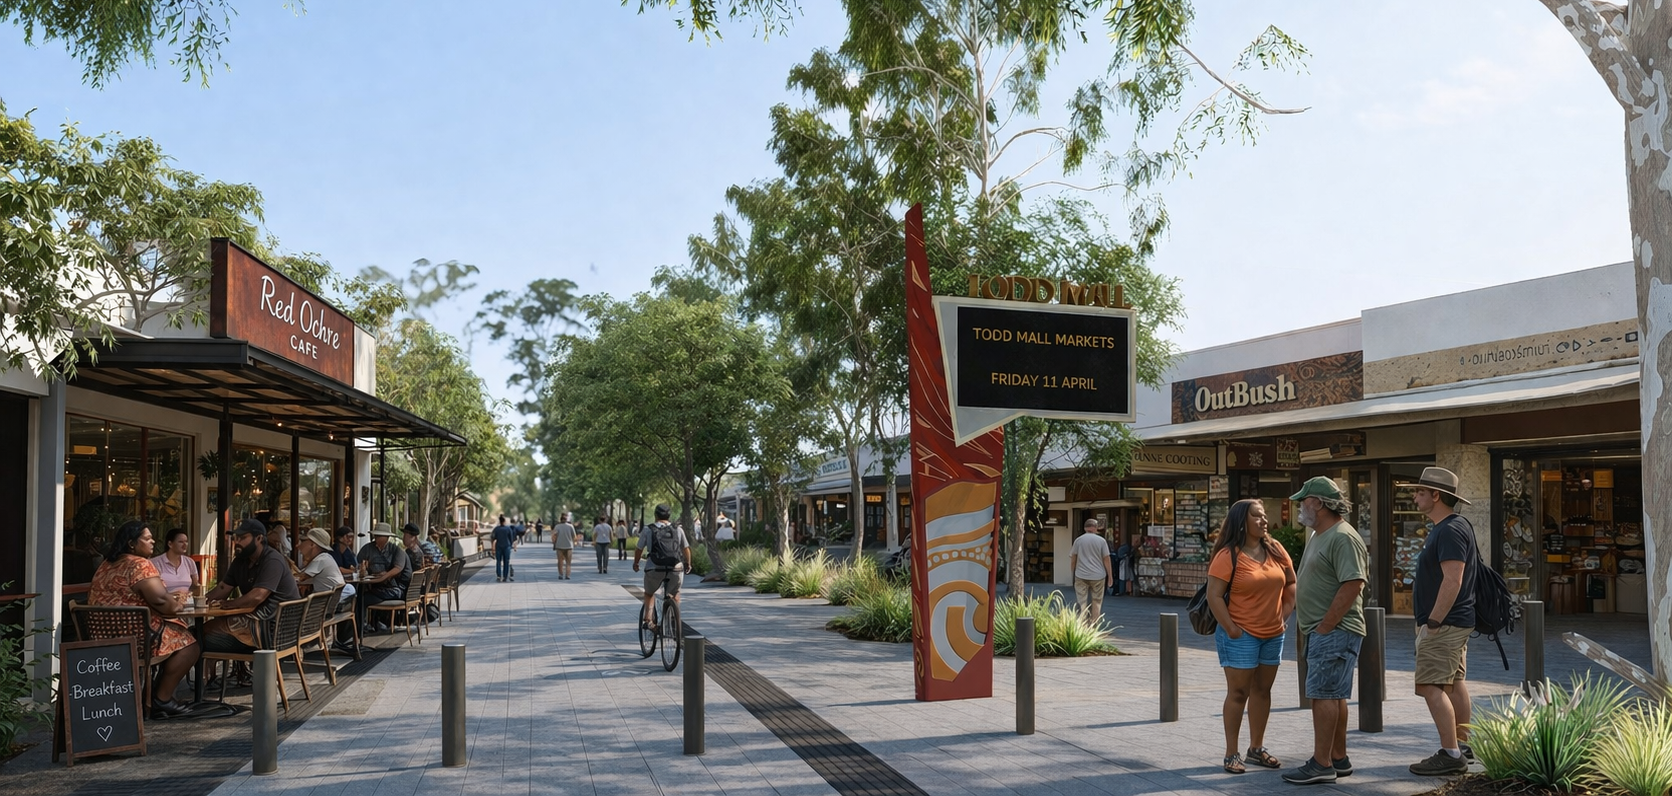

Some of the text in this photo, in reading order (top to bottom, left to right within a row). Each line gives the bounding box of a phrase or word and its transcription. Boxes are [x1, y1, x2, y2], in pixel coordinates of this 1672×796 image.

[261, 275, 340, 350] Red Ochre
[290, 334, 318, 360] CAFE
[972, 327, 1115, 349] TODD MALL MARKETS
[991, 372, 1098, 391] FRIDAY 11 APRIL
[1195, 374, 1297, 413] OutBush
[1165, 454, 1211, 467] COOTING
[76, 657, 122, 675] Coffee
[82, 702, 123, 721] Lunch
